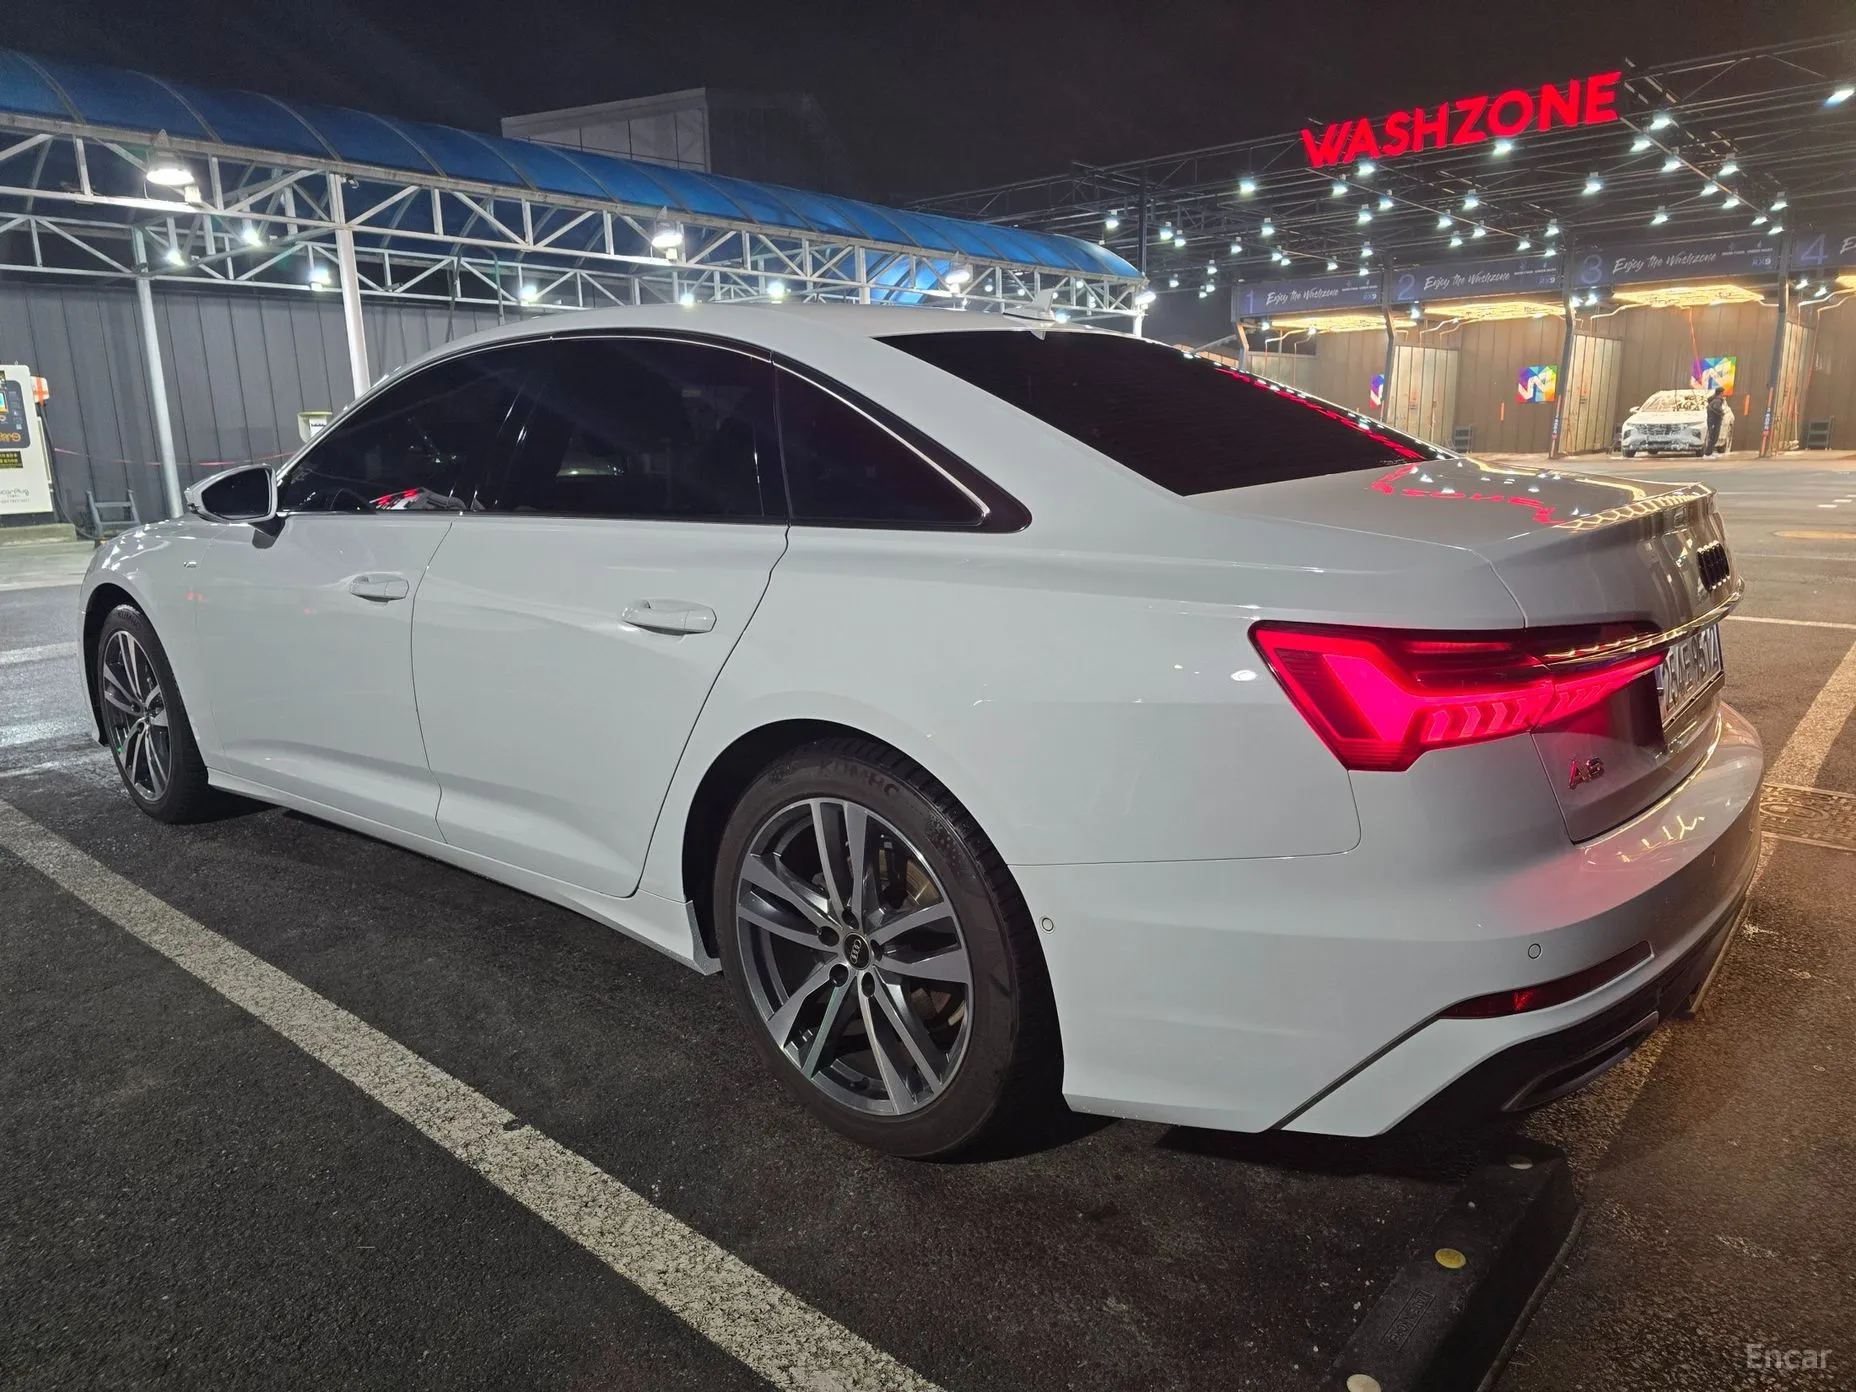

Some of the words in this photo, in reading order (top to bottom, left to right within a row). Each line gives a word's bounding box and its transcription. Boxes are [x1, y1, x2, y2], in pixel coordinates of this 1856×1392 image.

[1301, 71, 1622, 168] WASHZONE
[1800, 234, 1828, 264] 4
[1580, 254, 1603, 285] 3
[1612, 257, 1645, 275] Enjoy
[1398, 273, 1416, 300] 2
[1423, 275, 1450, 291] Enjoy
[1244, 289, 1254, 314] 1
[1266, 291, 1289, 305] Enjoy
[1568, 757, 1604, 790] A6
